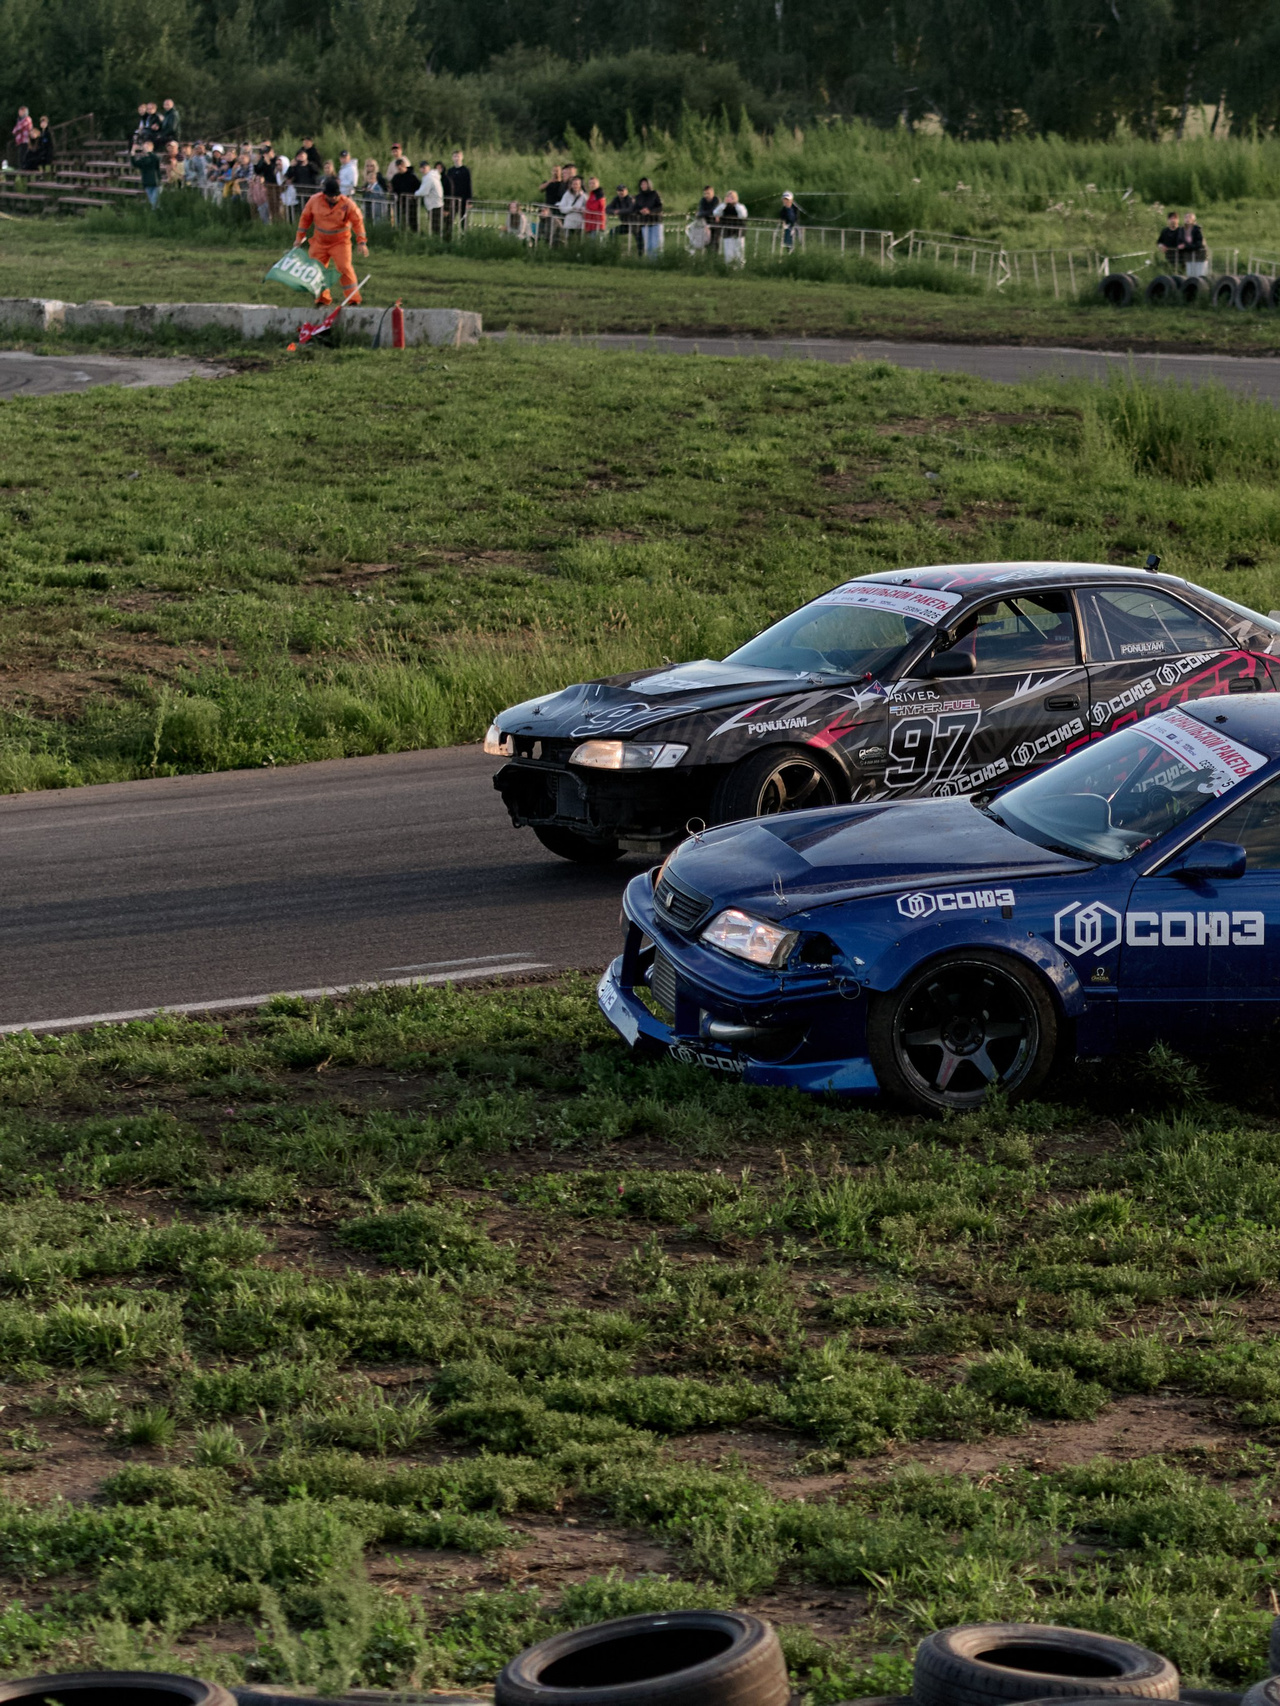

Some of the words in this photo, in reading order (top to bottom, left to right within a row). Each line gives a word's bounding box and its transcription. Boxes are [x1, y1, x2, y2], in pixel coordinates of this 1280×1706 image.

[910, 592, 954, 611] РАКЕТЫ
[919, 609, 941, 619] 2025
[1121, 641, 1165, 655] PONULYAM
[894, 691, 940, 703] RIVER
[896, 702, 942, 716] HYPER
[943, 699, 980, 712] FUEL
[1109, 678, 1157, 715] СОЮЗ
[748, 716, 808, 735] PONULYAM
[1034, 717, 1085, 754] СОЮЗ
[884, 709, 982, 788] 97
[1212, 745, 1256, 777] РАКЕТЫ
[957, 757, 1009, 792] СОЮЗ
[936, 889, 1015, 911] СОЮЗ
[1126, 911, 1265, 946] СОЮЗ
